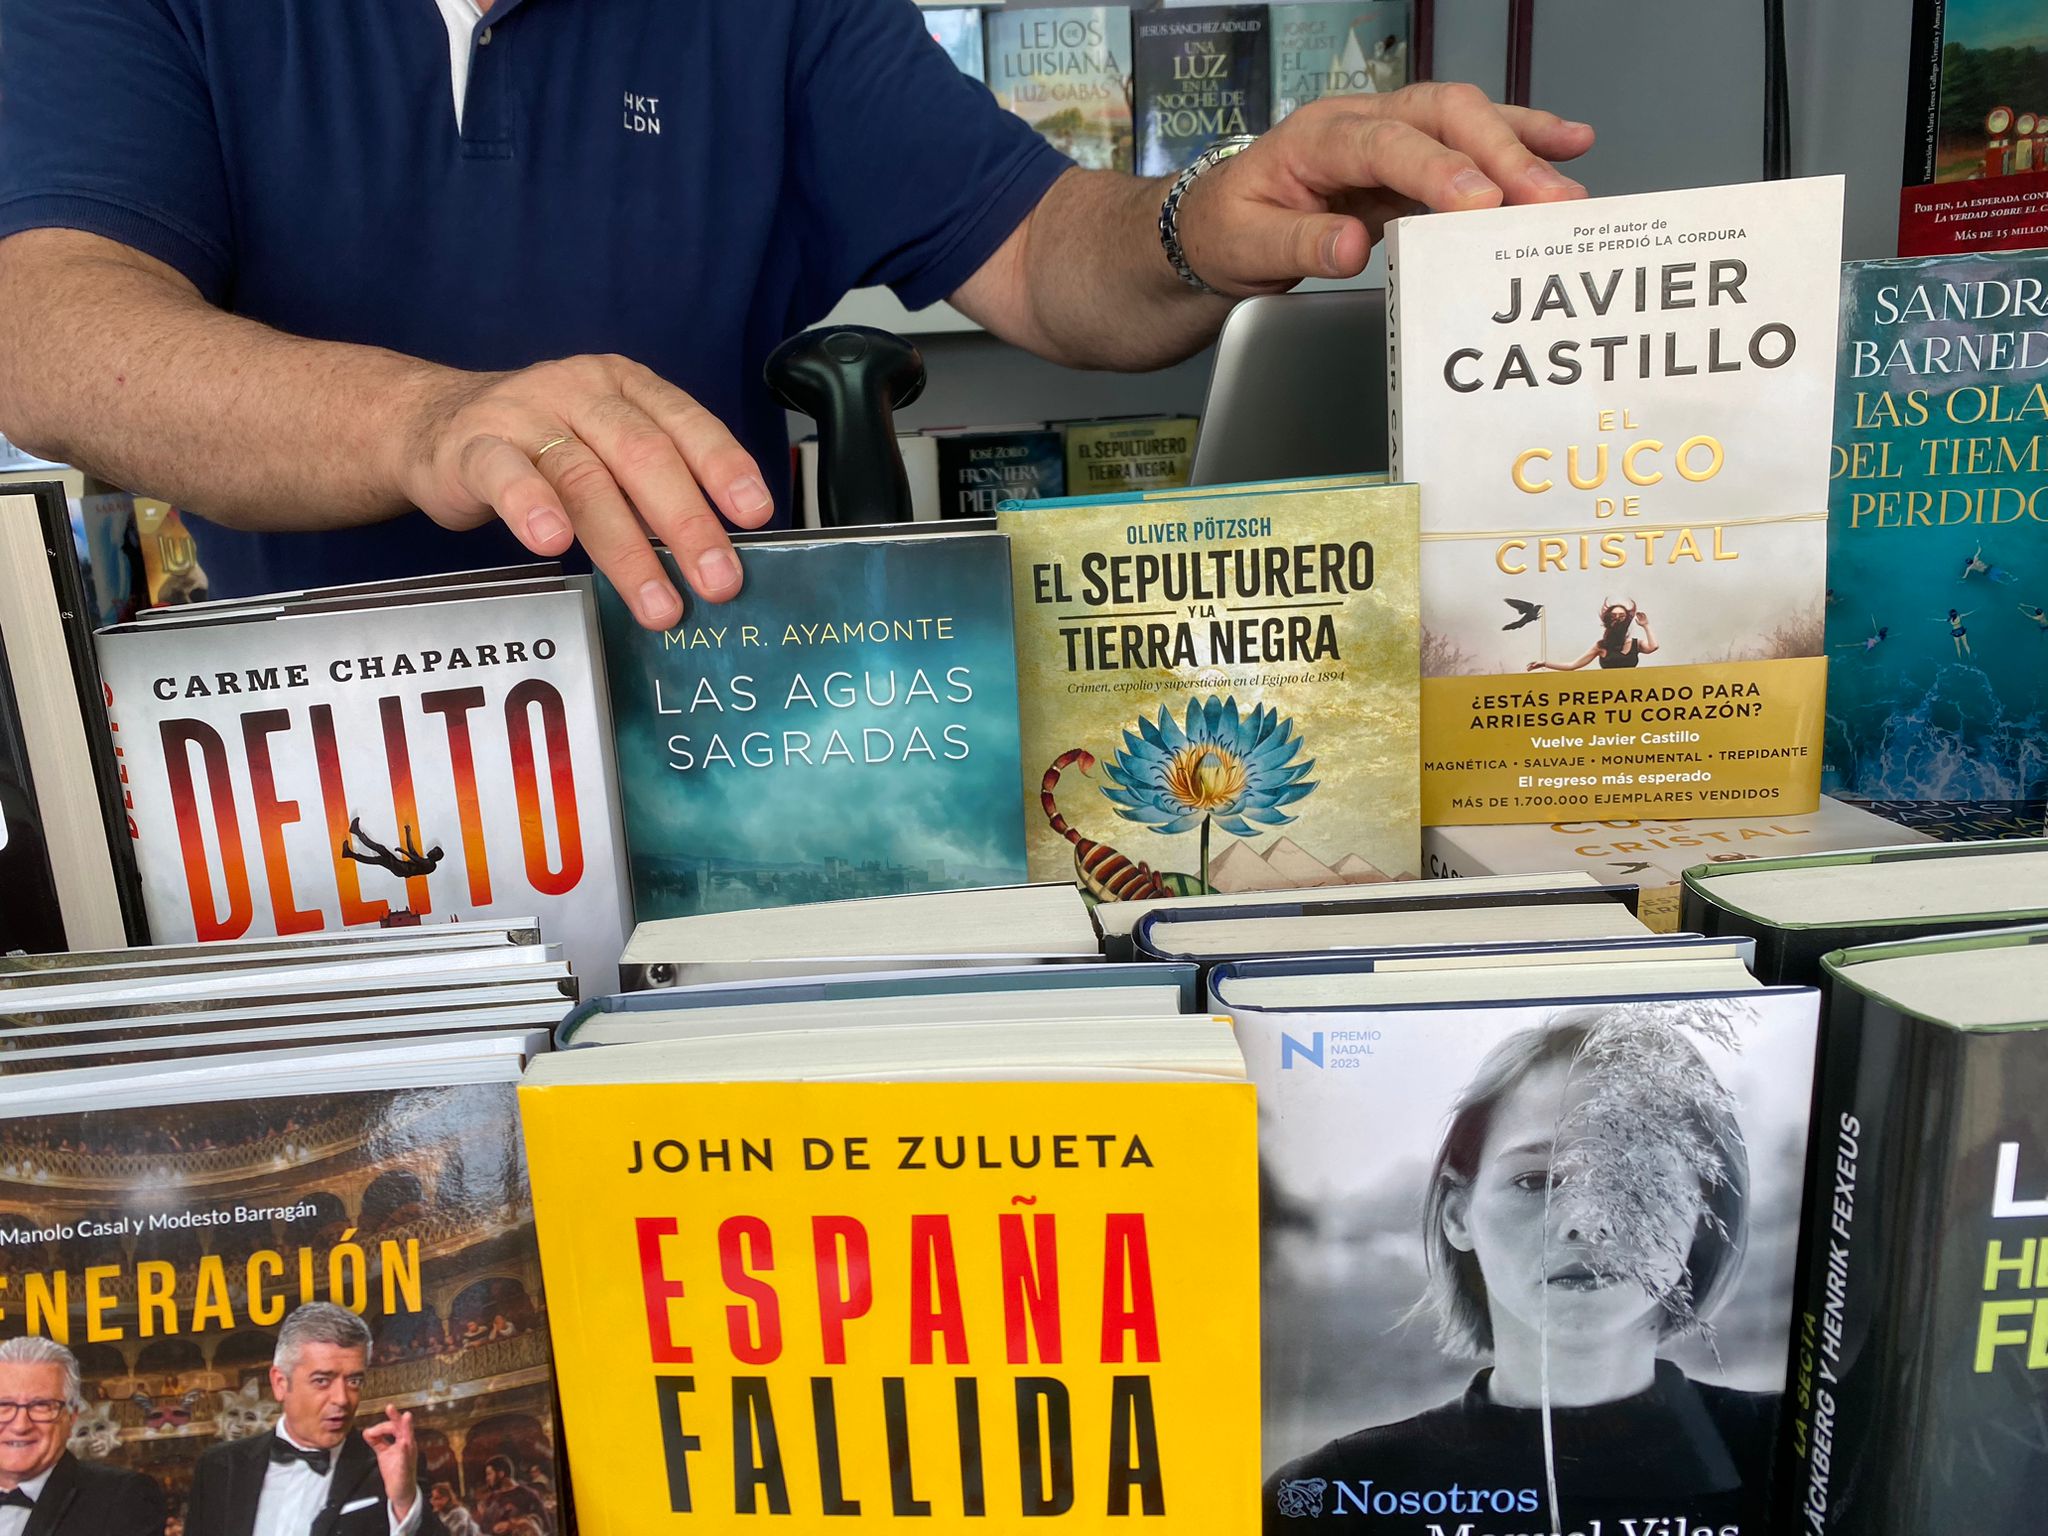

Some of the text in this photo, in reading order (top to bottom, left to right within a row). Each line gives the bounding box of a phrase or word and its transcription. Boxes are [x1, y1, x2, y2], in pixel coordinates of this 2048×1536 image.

[1020, 20, 1103, 49] LEJOS
[1184, 41, 1215, 54] UNA
[1004, 50, 1120, 77] LUISIANA
[1173, 54, 1228, 79] LUZ
[1282, 52, 1307, 71] EL
[1182, 79, 1218, 92] EN LA
[1281, 71, 1369, 93] LATIDO
[1929, 63, 1939, 90] Gallego
[623, 91, 659, 114] HKT
[1014, 84, 1047, 102] LUZ
[1157, 91, 1245, 109] NOCHE DE
[1928, 91, 1936, 112] Teresa
[623, 111, 660, 135] LDN
[1157, 107, 1248, 137] ROMA
[1926, 135, 1933, 143] de
[1950, 210, 1988, 221] VERDAD
[1990, 206, 2022, 217] SOBRE
[2025, 205, 2037, 213] EL
[1956, 200, 1968, 208] LA
[1970, 195, 2020, 207] ESPERADA
[1573, 219, 1667, 238] Por el autor de
[1979, 230, 1993, 239] DE
[1996, 229, 2008, 238] 15
[1495, 228, 1747, 261] EL DÍA QUE SE PERDIÓ LA CORDURA
[1491, 258, 1748, 324] JAVIER
[1874, 277, 2048, 326] SANDR
[1443, 322, 1797, 393] CASTILLO
[1598, 408, 1640, 431] EL
[1853, 389, 1929, 429] LAS
[1079, 438, 1187, 459] EL SEPULTURERO
[958, 465, 1039, 484] FRONTERA
[1088, 461, 1176, 480] TIERRA NEGRA
[1511, 435, 1725, 493] CUCO
[1595, 495, 1641, 518] DE
[1126, 516, 1272, 545] OLIVER PÖTZSCH
[1495, 526, 1739, 575] CRISTAL
[1033, 540, 1375, 606] EL SEPULTURERO
[1187, 604, 1216, 619] Y LA
[664, 617, 954, 650] MAY R. AYAMONTE
[1059, 614, 1341, 672] TIERRA NEGRA
[152, 638, 558, 702] CARME CHAPARRO
[1067, 671, 1346, 694] Crimen, expolio y superstición en el Egipto de 1894
[655, 667, 973, 715] LAS AGUAS
[1472, 682, 1761, 710] ¿ESTÁS PREPARADO PARA
[1470, 701, 1763, 729] ARRIESGAR TU CORAZÓN?
[667, 724, 970, 771] SAGRADAS
[1530, 730, 1700, 749] Vuelve Javier Castillo
[1424, 746, 1808, 771] MAGNÉTICA SALVAJE MONUMENTAL TREPIDANTE
[1518, 769, 1712, 790] El regreso más esperado
[158, 678, 585, 943] DELITO
[1452, 788, 1780, 809] MÁS DE 1.700.000 EJEMPLARES VENDIDOS
[1575, 825, 1810, 857] CRISTAL
[1643, 824, 1690, 834] DE
[1330, 1030, 1381, 1041] PREMIO
[1281, 1031, 1324, 1069] N
[1330, 1044, 1374, 1055] NADAL
[1330, 1058, 1360, 1069] 2023
[628, 1134, 1155, 1174] JOHN DE ZULUETA
[0, 1201, 317, 1246] Manolo Casal y Modesto Barragán
[0, 1227, 422, 1345] NERACIÓN
[634, 1195, 1162, 1365] ESPAÑA
[1803, 1112, 1861, 1536] ÄCKBERG Y HENRIK FEXEUS
[1793, 1312, 1817, 1459] LA SECTA
[654, 1375, 1167, 1516] FALLIDA
[1331, 1480, 1539, 1517] Nosotros
